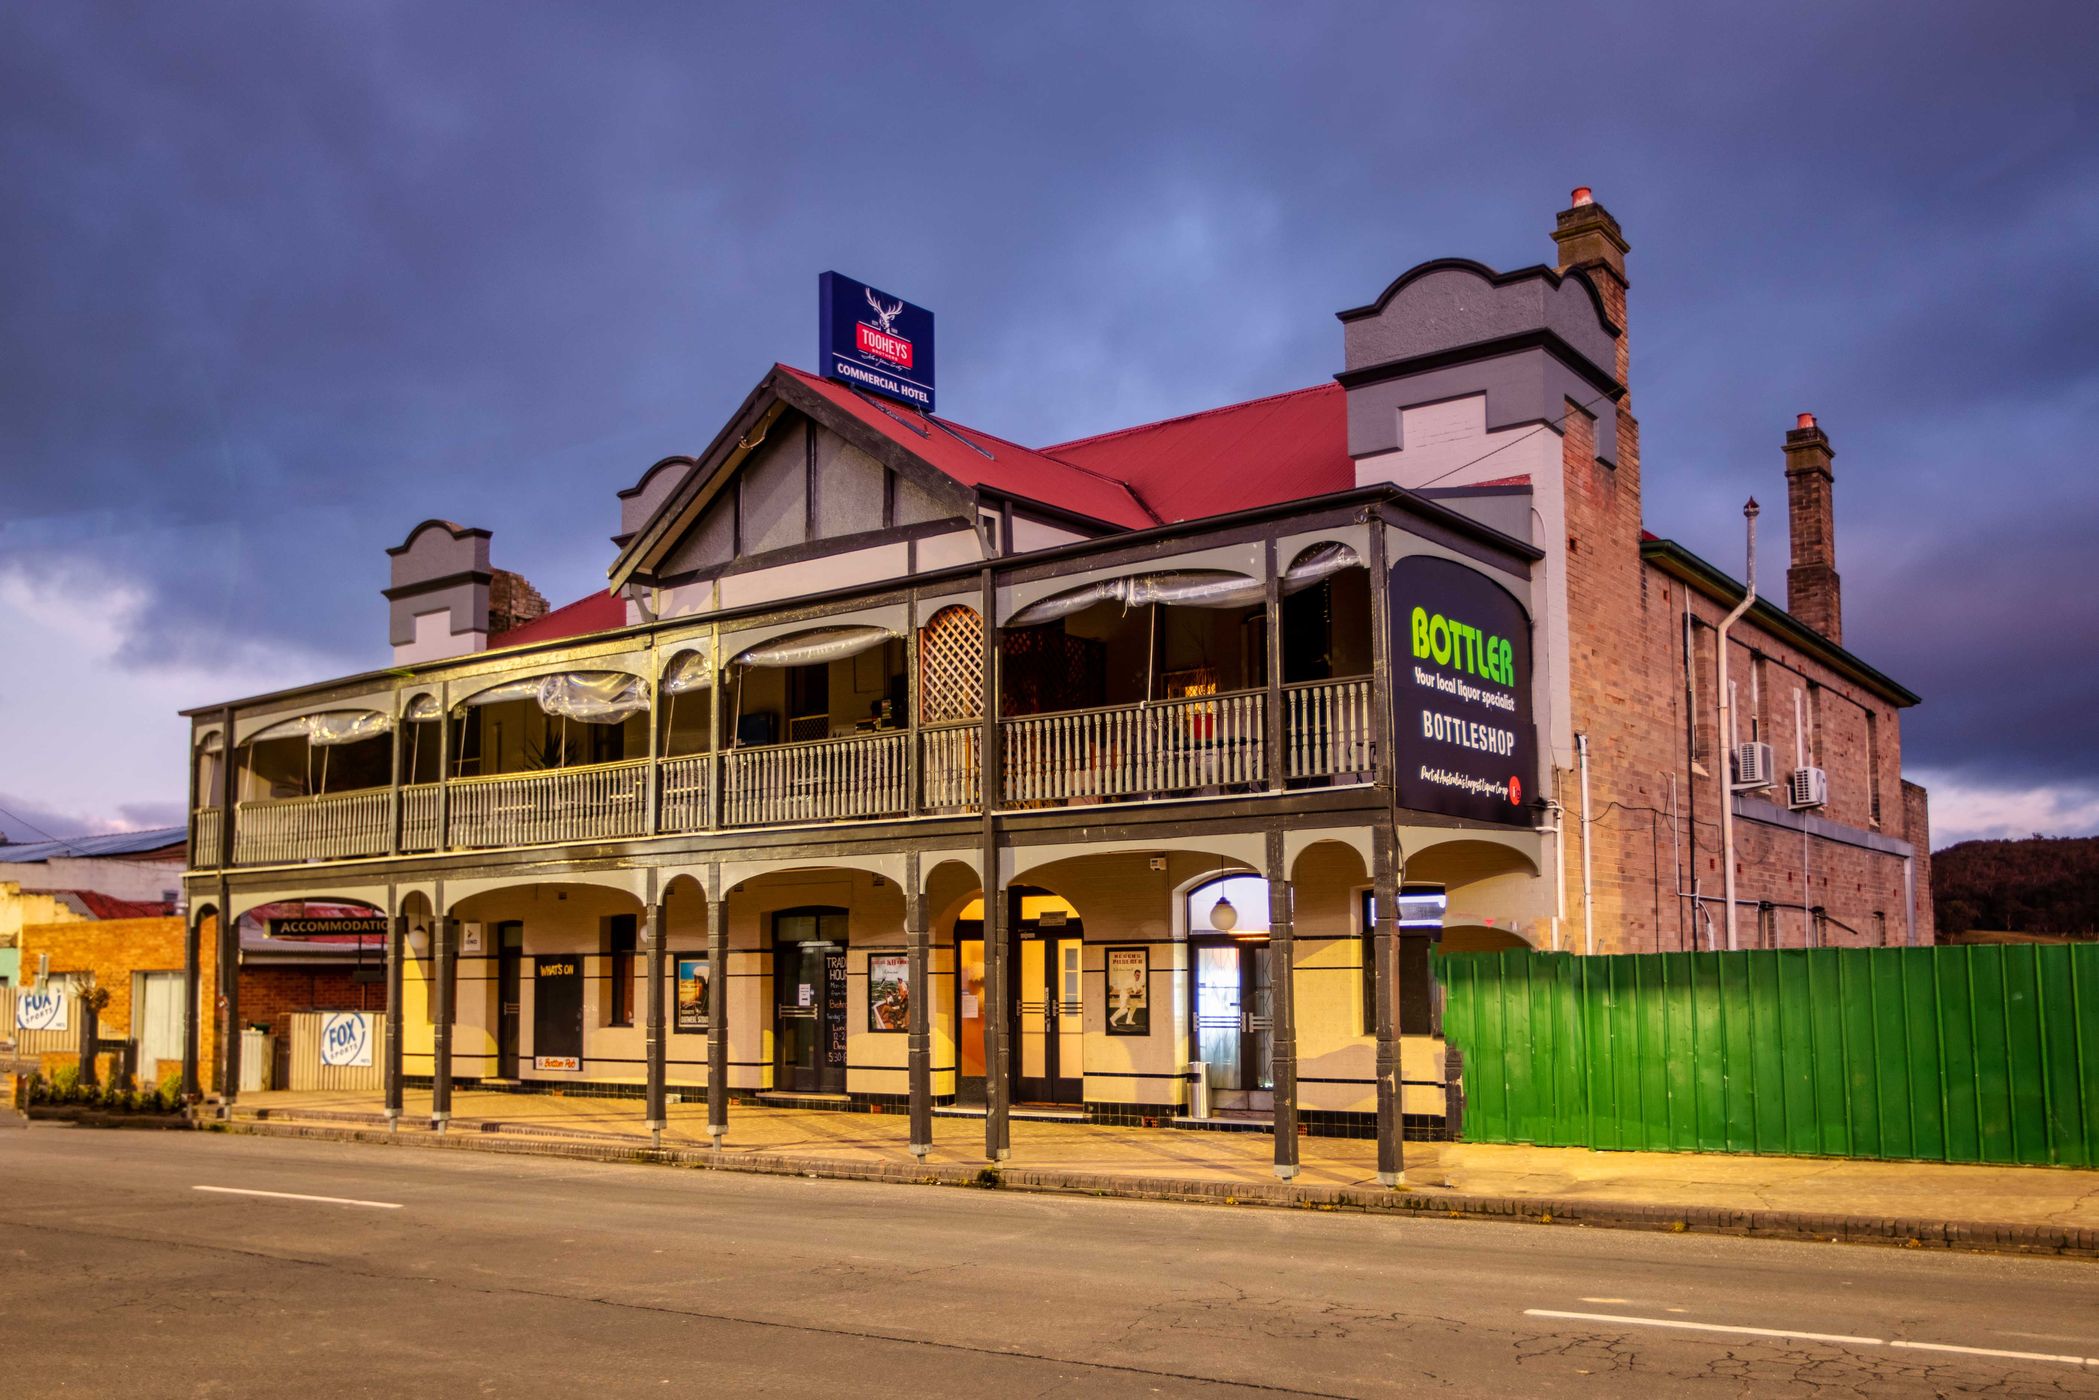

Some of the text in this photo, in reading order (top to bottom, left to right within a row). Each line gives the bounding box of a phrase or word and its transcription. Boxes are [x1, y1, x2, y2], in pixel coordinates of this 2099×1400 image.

[862, 328, 908, 360] TOOHEYS
[837, 363, 929, 403] COMMERCIAL HOTEL
[1412, 606, 1514, 688] BOTTLER
[1414, 666, 1515, 712] Your local liquor specialist
[1423, 710, 1514, 757] BOTTLESHOP
[280, 920, 388, 933] ACCOMMODATIO
[563, 964, 574, 976] ON
[826, 956, 846, 969] TRAD
[329, 1018, 356, 1052] FOX
[330, 1042, 358, 1060] SPORTS
